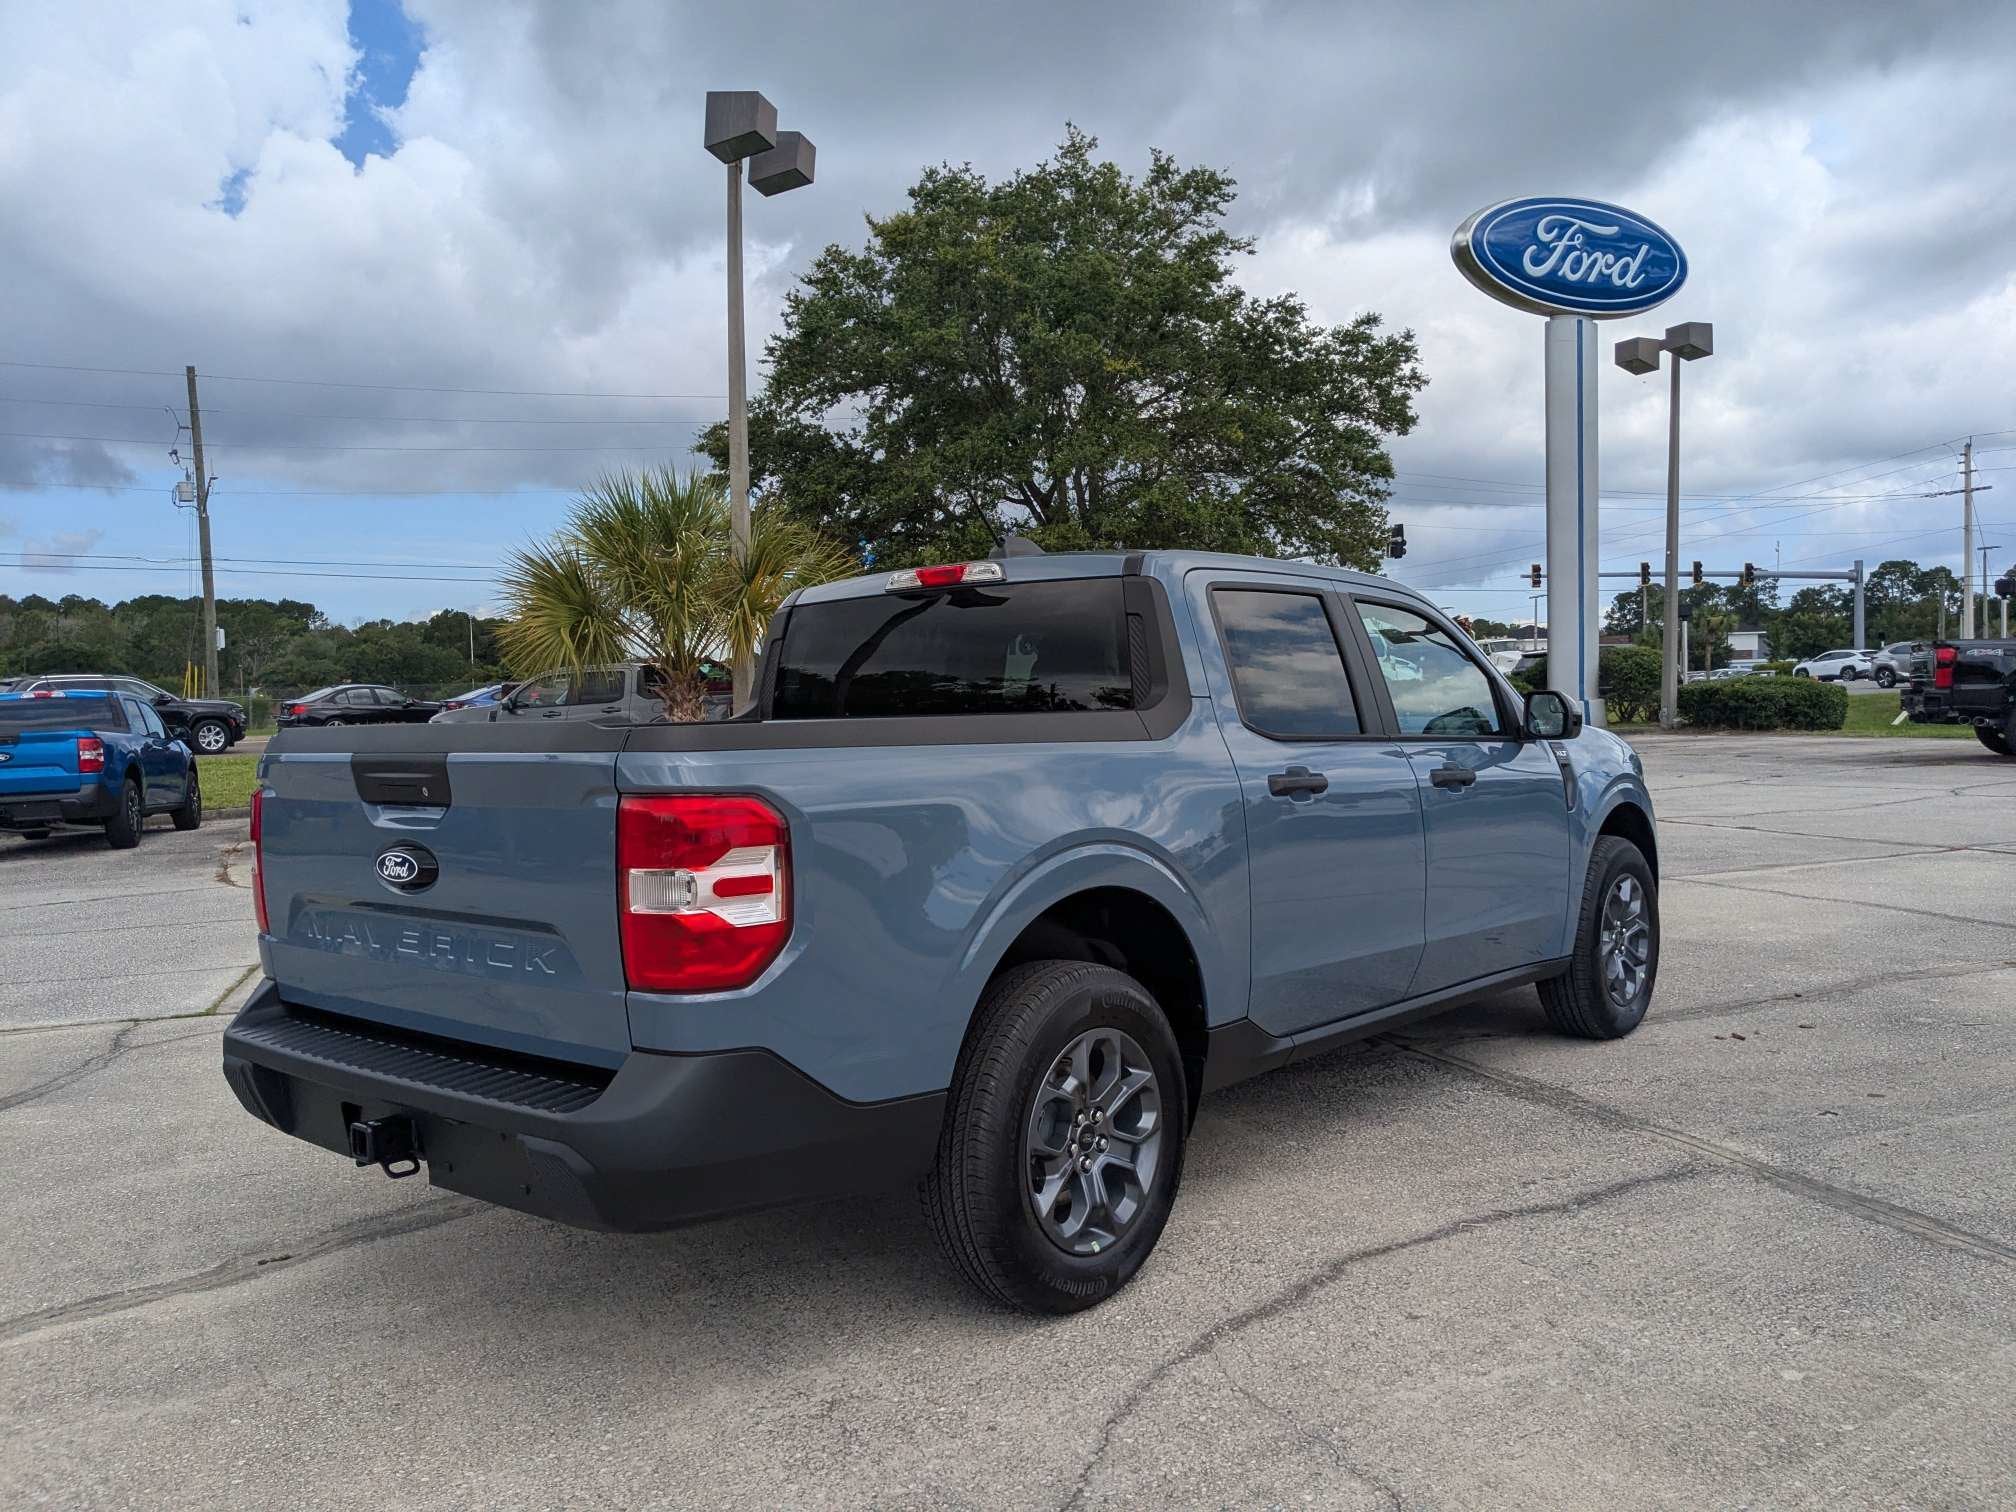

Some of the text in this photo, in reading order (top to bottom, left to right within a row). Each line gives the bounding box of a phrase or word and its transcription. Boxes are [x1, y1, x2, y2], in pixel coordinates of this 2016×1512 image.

[1523, 215, 1648, 288] Ford
[383, 856, 408, 877] Ford
[307, 914, 557, 974] MAVERICK
